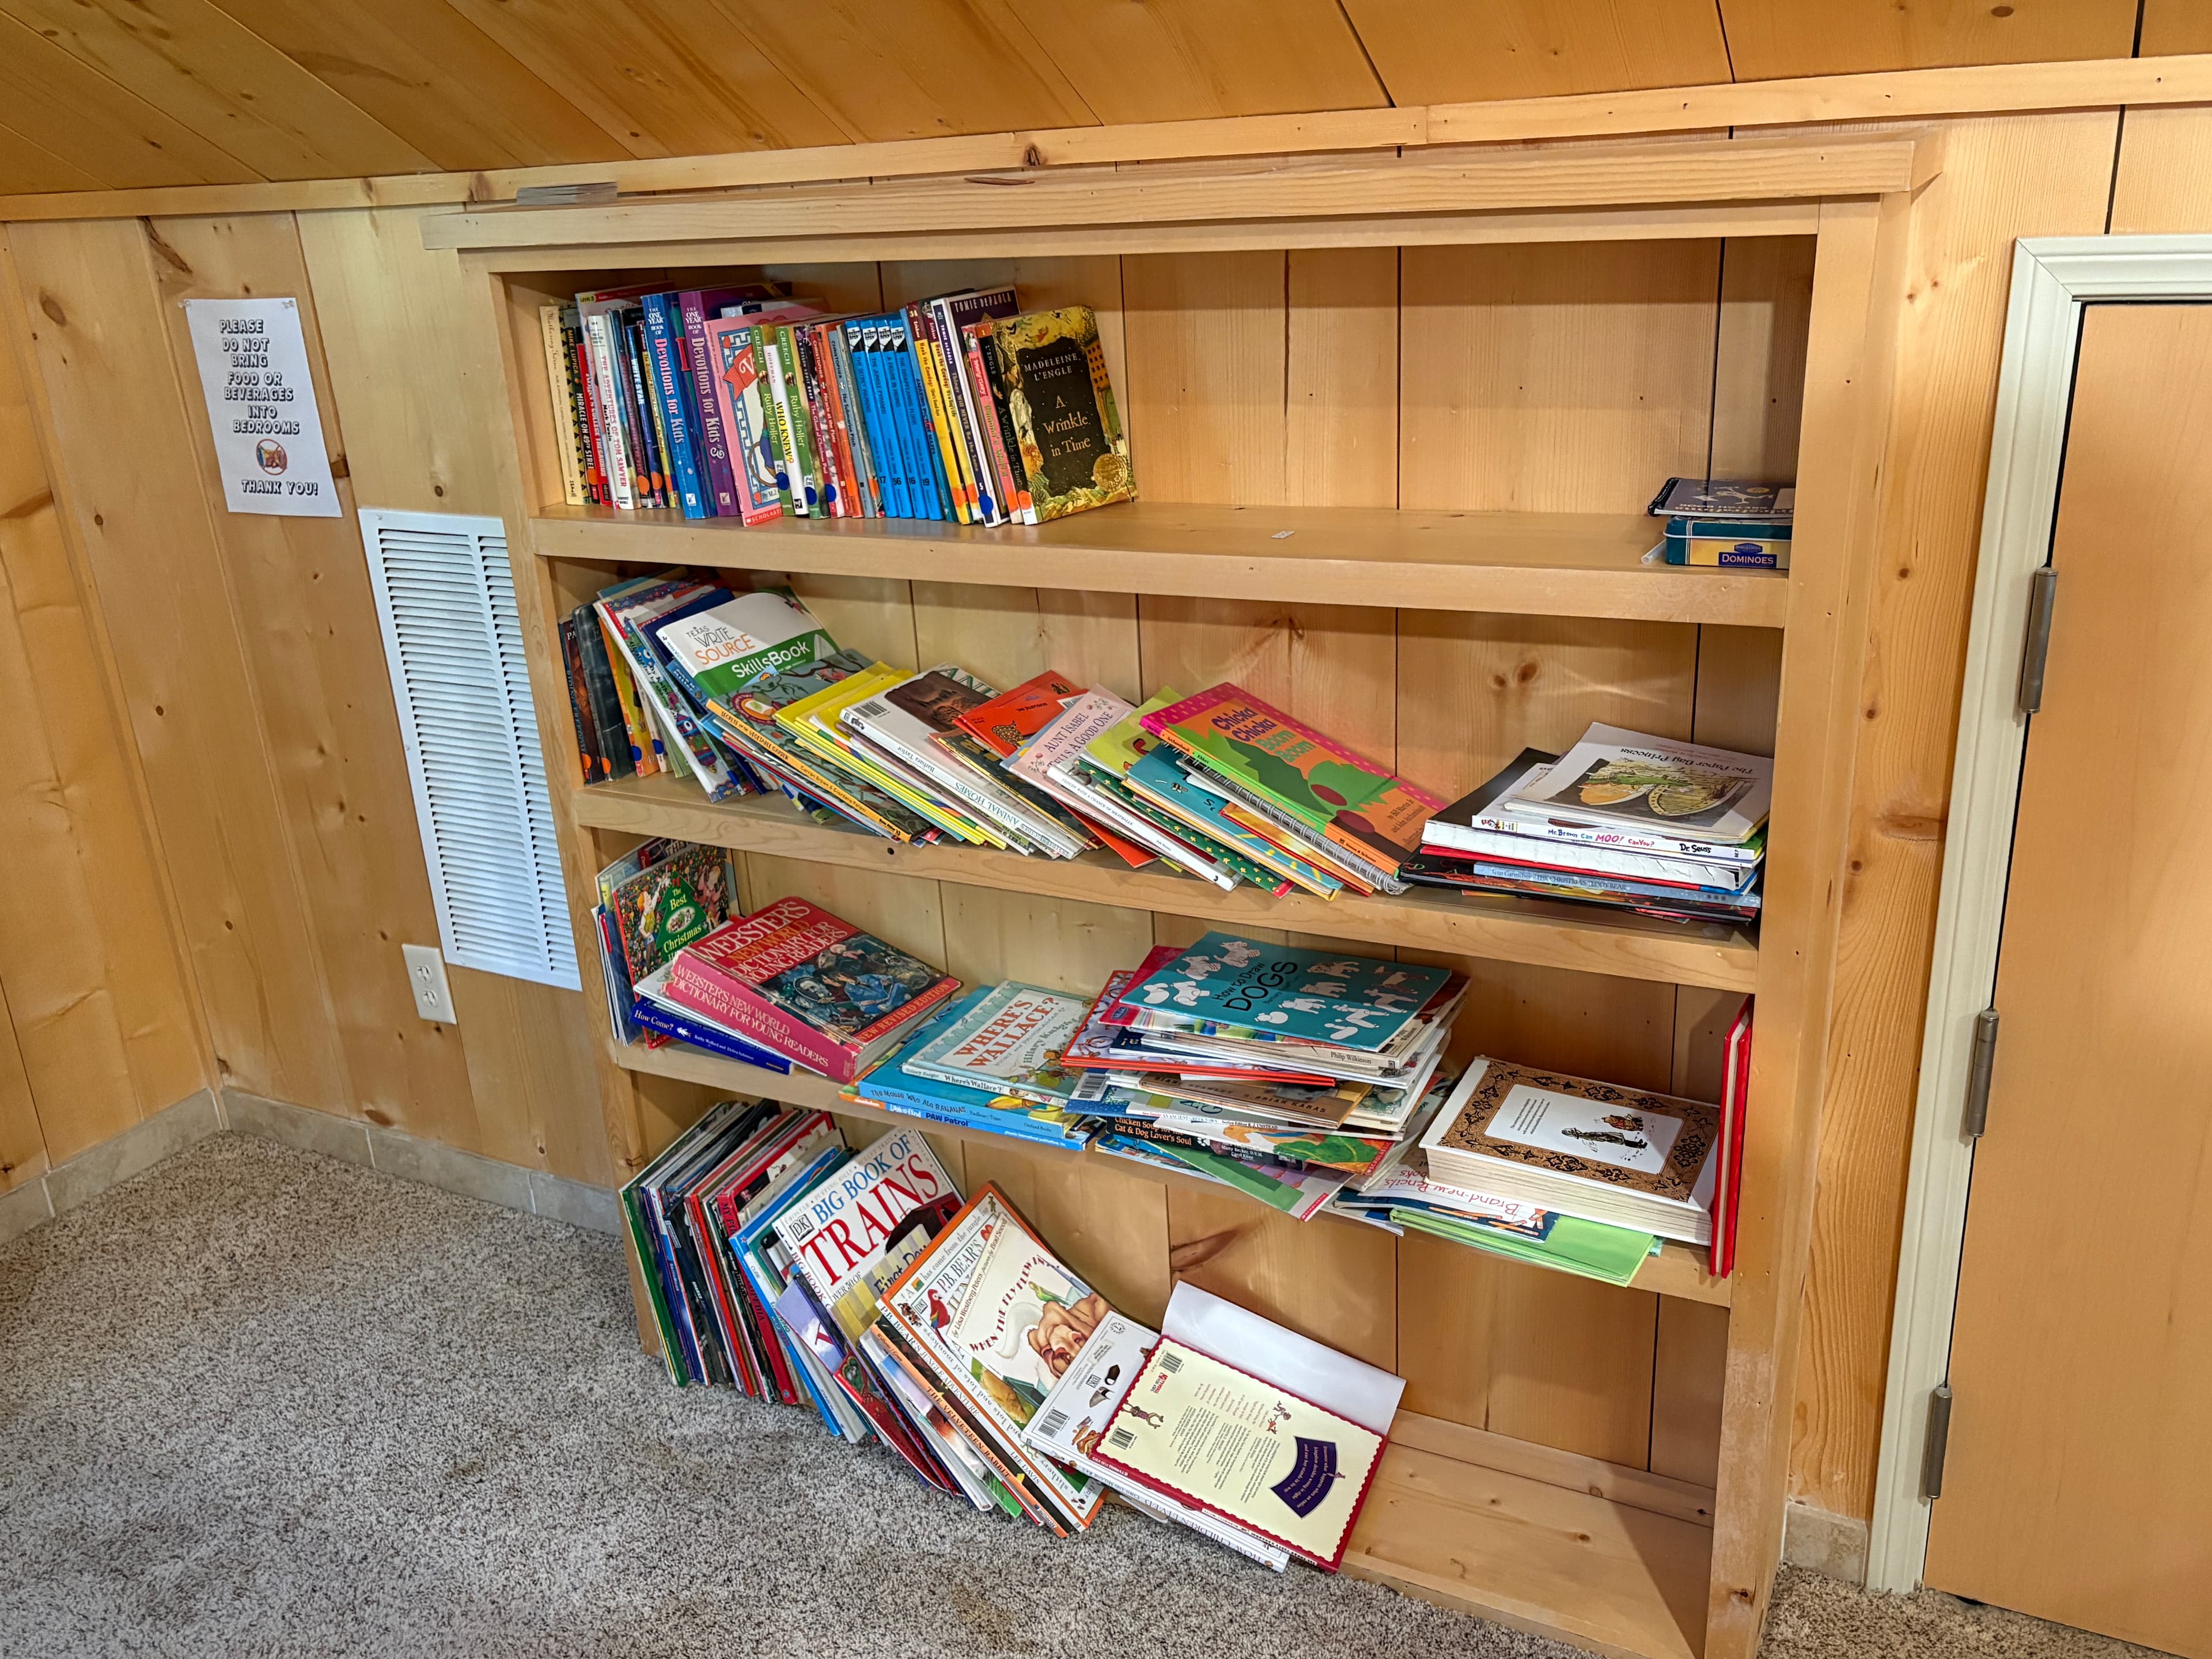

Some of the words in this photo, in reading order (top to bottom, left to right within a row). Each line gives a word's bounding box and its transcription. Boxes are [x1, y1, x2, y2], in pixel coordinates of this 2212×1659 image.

[955, 299, 978, 313] TOMIE
[219, 320, 263, 334] PLEASE
[648, 317, 664, 325] YEAR
[223, 338, 238, 352] DO
[243, 338, 270, 353] NOT
[754, 329, 764, 363] CREECH
[780, 331, 791, 365] CREECH
[232, 354, 268, 368] BRING
[570, 349, 578, 374] LUPICA
[654, 338, 675, 396] Devotions
[691, 336, 711, 395] Devotions
[813, 340, 824, 378] CHRISTOPHER
[831, 340, 842, 378] CHRISTOPHER
[985, 345, 997, 374] L'ENGLE
[1023, 352, 1079, 373] MADELEINE
[228, 372, 259, 386] FOOD
[264, 373, 282, 386] OR
[1033, 365, 1074, 382] L'ENGLE
[224, 387, 294, 402] BEVERAGES
[576, 393, 586, 419] MIRACLE
[603, 374, 617, 424] ADVENTURES
[1055, 395, 1066, 409] A
[248, 406, 277, 419] INTO
[666, 399, 679, 415] for
[702, 399, 714, 415] for
[764, 393, 772, 415] Ruby
[768, 418, 778, 444] Holler
[843, 403, 854, 434] Submarine
[233, 420, 300, 435] BEDROOMS
[671, 418, 685, 444] Kids
[706, 416, 721, 443] Kids
[775, 402, 786, 427] WHO
[781, 429, 794, 464] KNEW?
[790, 395, 800, 418] Ruby
[795, 420, 804, 447] Holler
[1042, 411, 1089, 434] Wrinkle
[613, 437, 622, 455] TOM
[1001, 416, 1017, 453] Wrinkle
[1013, 461, 1023, 486] Time
[1050, 444, 1061, 457] in
[1061, 437, 1092, 453] Time
[616, 457, 627, 487] SAWYER
[879, 476, 887, 484] 17
[893, 477, 902, 486] 56
[908, 476, 916, 485] 16
[922, 478, 930, 486] 19
[241, 480, 282, 495] THANK
[286, 481, 319, 496] YOU!
[1721, 554, 1774, 565] DOMINOES
[685, 626, 710, 638] TEXAS
[694, 627, 734, 648] WRITE
[695, 633, 756, 665] SOURCE
[732, 641, 811, 679] SkillsBook
[1078, 727, 1101, 746] GOOD
[1097, 711, 1114, 732] ONE
[1211, 707, 1258, 731] Chicka
[1232, 718, 1278, 743] Chicka
[1044, 731, 1065, 753] AUNT
[1065, 713, 1089, 734] ISABEL
[1255, 730, 1297, 751] Boom
[748, 729, 772, 749] VEGETABLE
[771, 744, 790, 762] GARDEN
[897, 746, 918, 761] Taylor
[1274, 740, 1317, 763] Boom
[1620, 747, 1669, 761] Princess
[914, 756, 935, 774] Barbara
[1672, 755, 1695, 767] Bag
[1697, 760, 1729, 773] Paper
[1731, 766, 1754, 775] The
[955, 782, 988, 804] HOMES
[986, 802, 1021, 826] ANIMAL
[1557, 829, 1578, 839] Brown
[1595, 834, 1625, 845] MOO!
[1679, 843, 1691, 853] Dr.
[1691, 844, 1712, 854] Seuss
[672, 887, 681, 896] The
[1548, 874, 1586, 886] CHRISTMAS
[1587, 879, 1608, 889] TEDDY
[1608, 881, 1628, 891] BEAR
[669, 893, 688, 911] Best
[663, 924, 702, 953] Christmas
[698, 900, 810, 961] WEBSTER'S
[726, 941, 757, 964] NEW
[757, 920, 810, 949] WORLD
[730, 931, 805, 977] DICTIONARY
[803, 920, 835, 941] FOR
[744, 953, 793, 983] YOUNG
[790, 929, 848, 965] READERS
[1211, 987, 1234, 1002] How
[1232, 978, 1244, 988] to
[1240, 962, 1267, 982] Draw
[1222, 961, 1298, 1012] DOGS
[677, 964, 730, 1002] WEBSTER'S
[730, 995, 753, 1015] NEW
[754, 1007, 790, 1035] WORLD
[634, 1010, 650, 1021] How
[650, 1016, 675, 1031] Come?
[672, 977, 733, 1015] DICTIONARY
[730, 1009, 751, 1026] FOR
[750, 1017, 783, 1043] YOUNG
[783, 1036, 829, 1067] READERS
[858, 1027, 879, 1042] NEW
[879, 1004, 917, 1030] REVISED
[916, 983, 950, 1007] EDITION
[953, 1000, 1033, 1056] WHERE'S
[967, 997, 1060, 1066] WALLACE?
[1330, 1051, 1346, 1062] Philip
[1346, 1052, 1373, 1065] Wilkinson
[944, 1074, 970, 1087] Where's
[969, 1080, 1003, 1093] Wallace?
[870, 1089, 883, 1097] The
[883, 1090, 905, 1100] Mouse
[906, 1093, 921, 1104] Who
[922, 1099, 934, 1109] Ate
[935, 1103, 967, 1115] BANANAS
[1253, 1094, 1287, 1106] BRIAN
[1291, 1101, 1327, 1114] KARAS
[925, 1112, 944, 1123] PAW
[943, 1116, 969, 1127] Patrol
[1115, 1116, 1141, 1127] Chicken
[1115, 1124, 1127, 1134] Cat
[1134, 1127, 1149, 1138] Dog
[1150, 1130, 1176, 1143] Lover's
[1176, 1135, 1192, 1146] Soul
[812, 1190, 845, 1225] BIG
[842, 1151, 892, 1200] BOOK
[889, 1134, 914, 1161] OF
[1384, 1178, 1430, 1193] Pencils
[1434, 1184, 1521, 1215] Brand-new
[799, 1153, 939, 1286] TRAINS
[933, 1255, 946, 1270] come
[936, 1271, 958, 1293] P.B.
[950, 1238, 984, 1274] BEAR'S
[791, 1252, 805, 1271] BIG
[805, 1272, 826, 1302] BOOK
[1016, 1260, 1033, 1290] FLEW
[960, 1287, 977, 1318] Westberg
[972, 1271, 984, 1293] Peters
[1001, 1286, 1017, 1306] FLY
[996, 1309, 1007, 1333] THE
[969, 1335, 999, 1353] WHEN
[893, 1323, 922, 1352] BEAR'S
[920, 1351, 946, 1378] JUNGLE
[942, 1377, 980, 1416] ADVENTURE
[926, 1386, 944, 1404] THE
[943, 1404, 984, 1450] VELVETEEN
[983, 1449, 1012, 1479] RABBIT
[1009, 1450, 1024, 1466] LEE
[1022, 1464, 1041, 1484] DAVIS
[1181, 1514, 1234, 1551] CHILDREN
